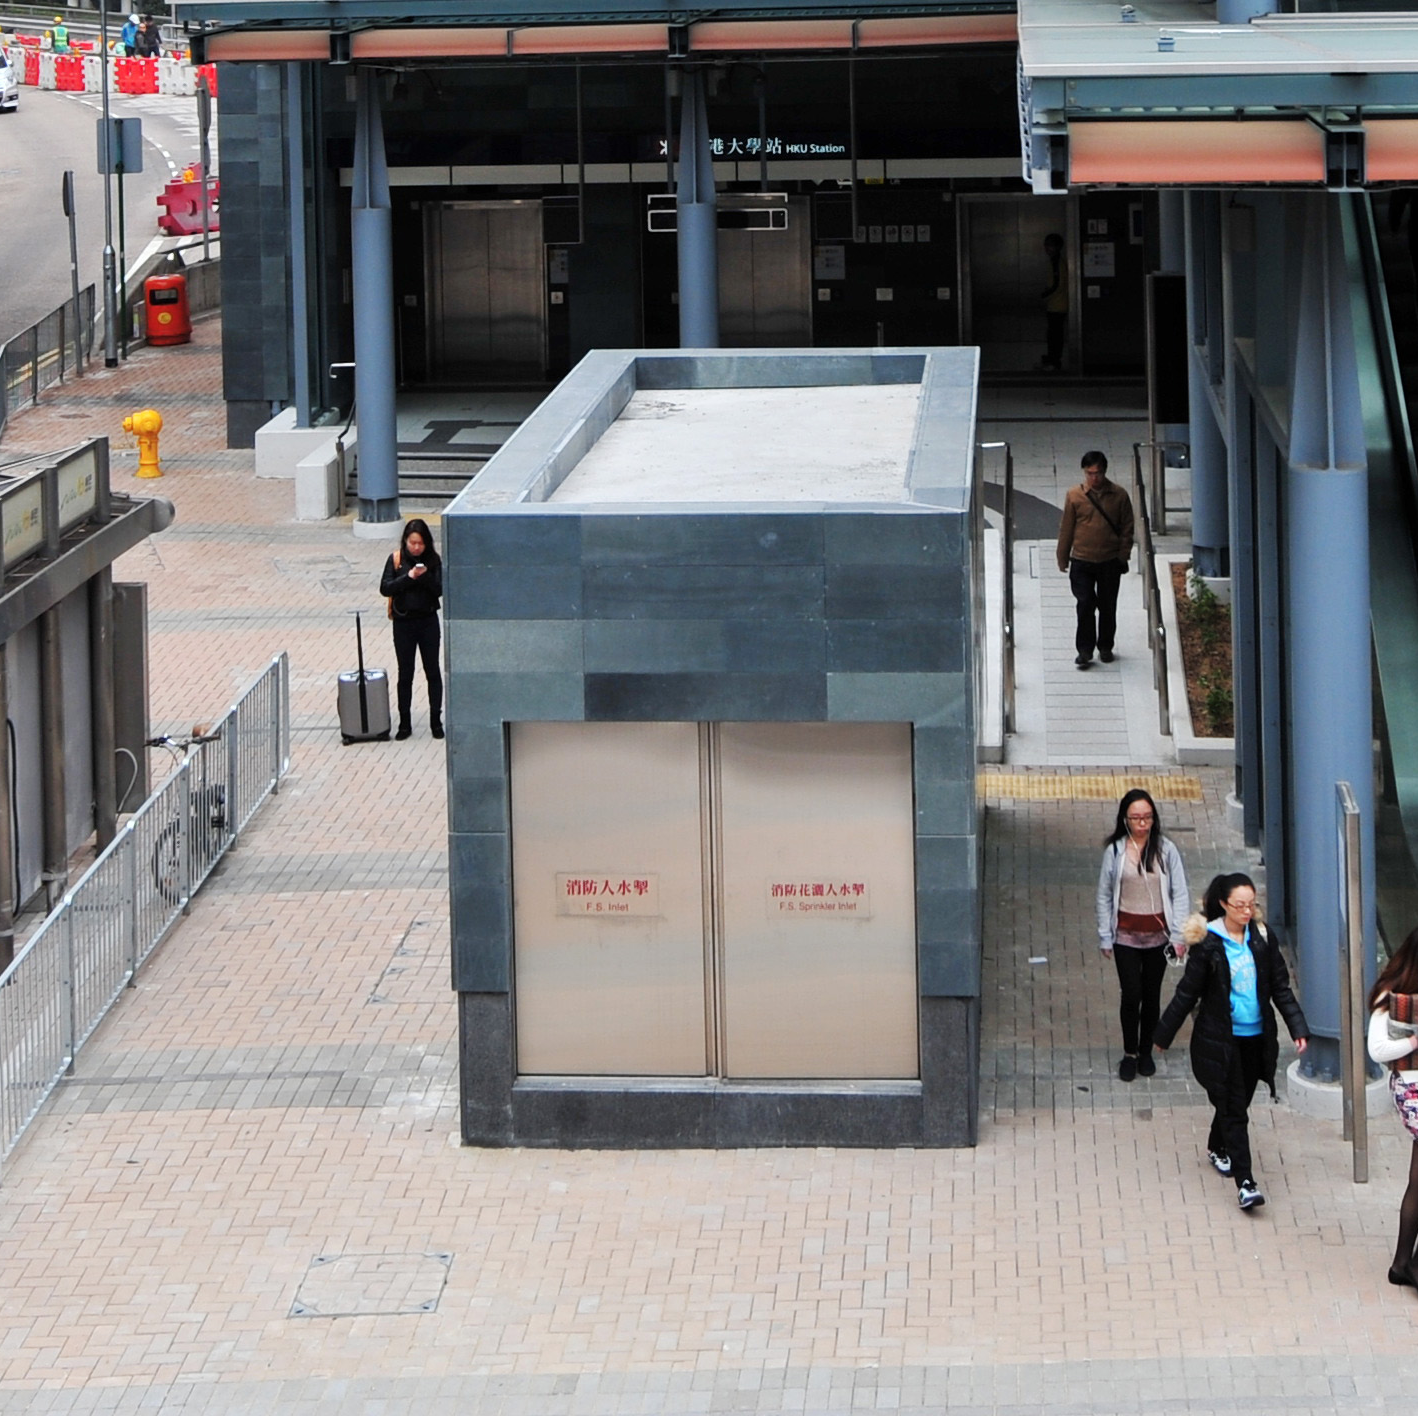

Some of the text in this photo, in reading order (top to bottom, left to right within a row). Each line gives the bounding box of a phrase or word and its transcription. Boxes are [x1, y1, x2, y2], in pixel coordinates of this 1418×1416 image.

[786, 144, 807, 154] HKU
[810, 142, 845, 154] Station
[608, 902, 630, 912] Inlet
[799, 901, 836, 913] Sprinkler
[838, 901, 857, 911] Inlet
